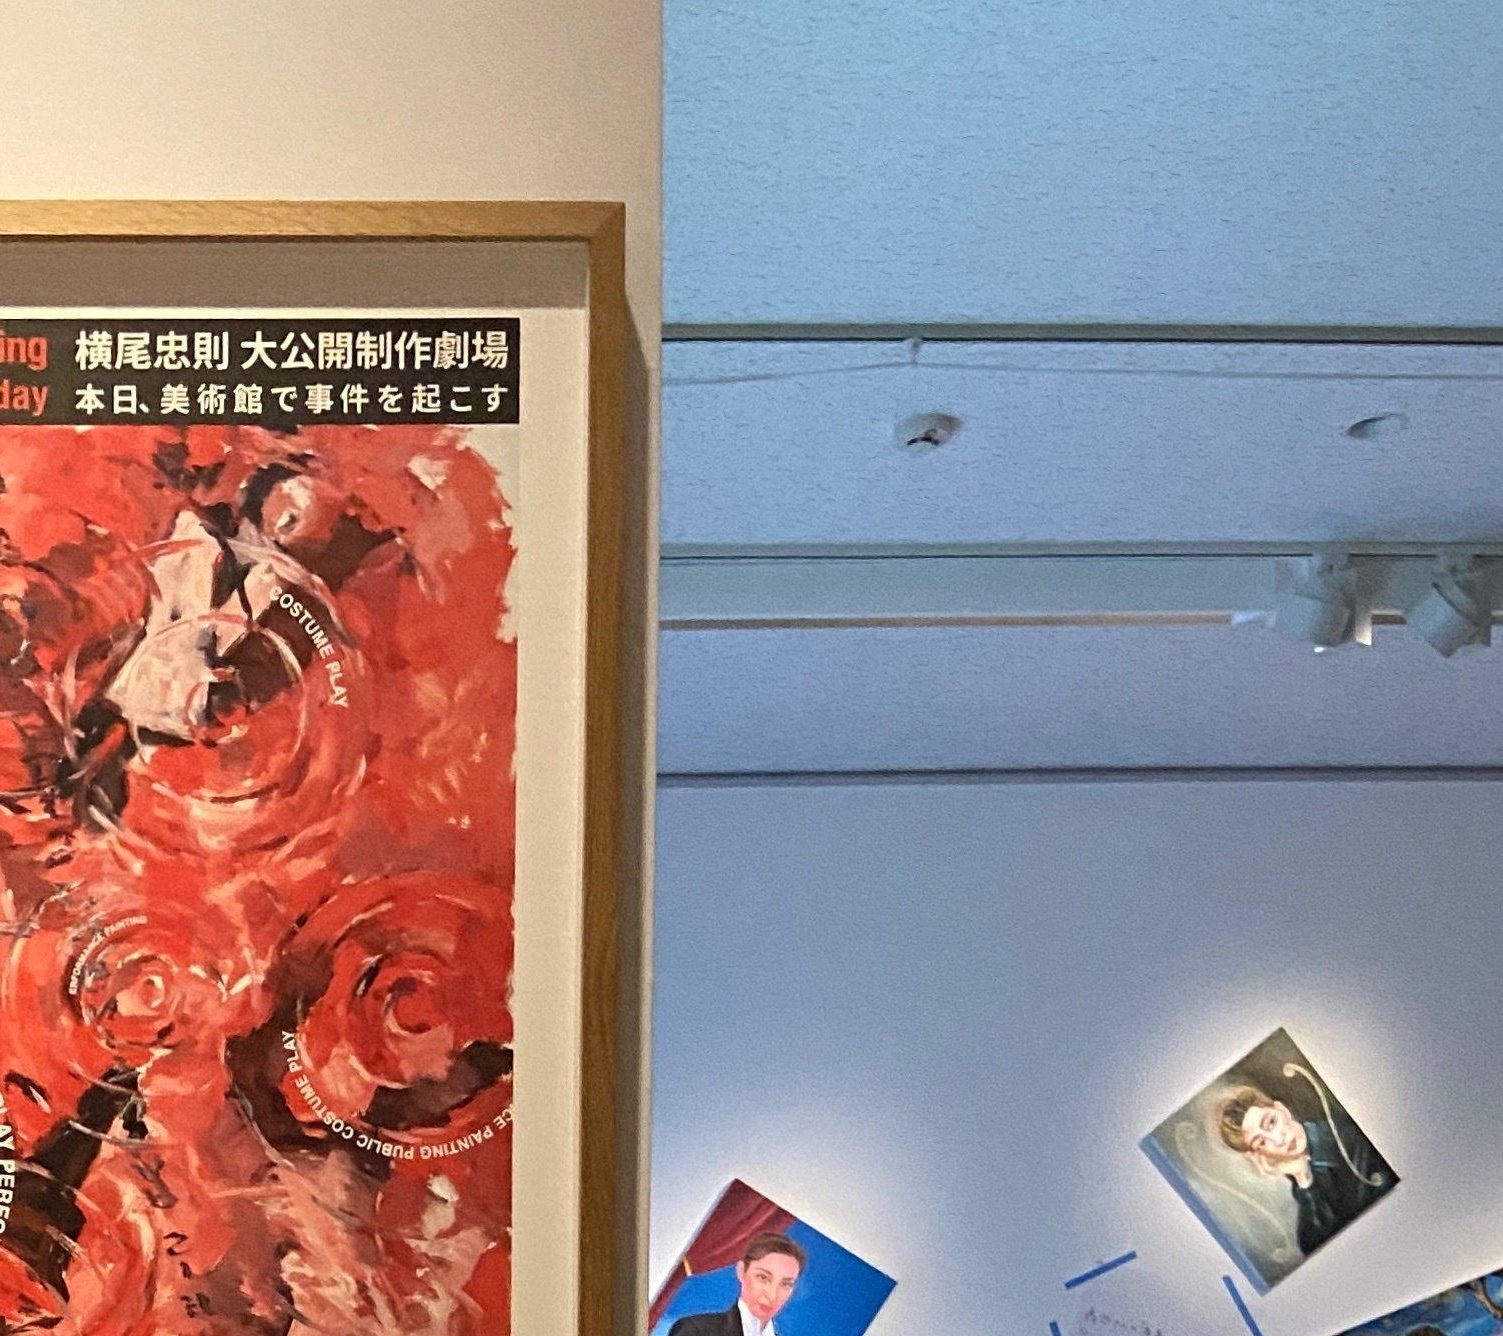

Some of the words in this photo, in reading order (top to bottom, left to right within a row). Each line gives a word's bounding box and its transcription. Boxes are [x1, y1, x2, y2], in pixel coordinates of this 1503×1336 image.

[75, 330, 229, 371] 横尾忠則
[240, 331, 510, 371] 大公開制作劇場
[75, 383, 503, 416] 本日、美術館で事件を起こす
[270, 586, 335, 659] COSTUME
[325, 660, 350, 708] PLAY
[281, 1030, 303, 1073] PLAY
[295, 1074, 354, 1140] COSTUME
[356, 1135, 414, 1160] PUBLIC
[420, 1129, 495, 1160] PAINTING
